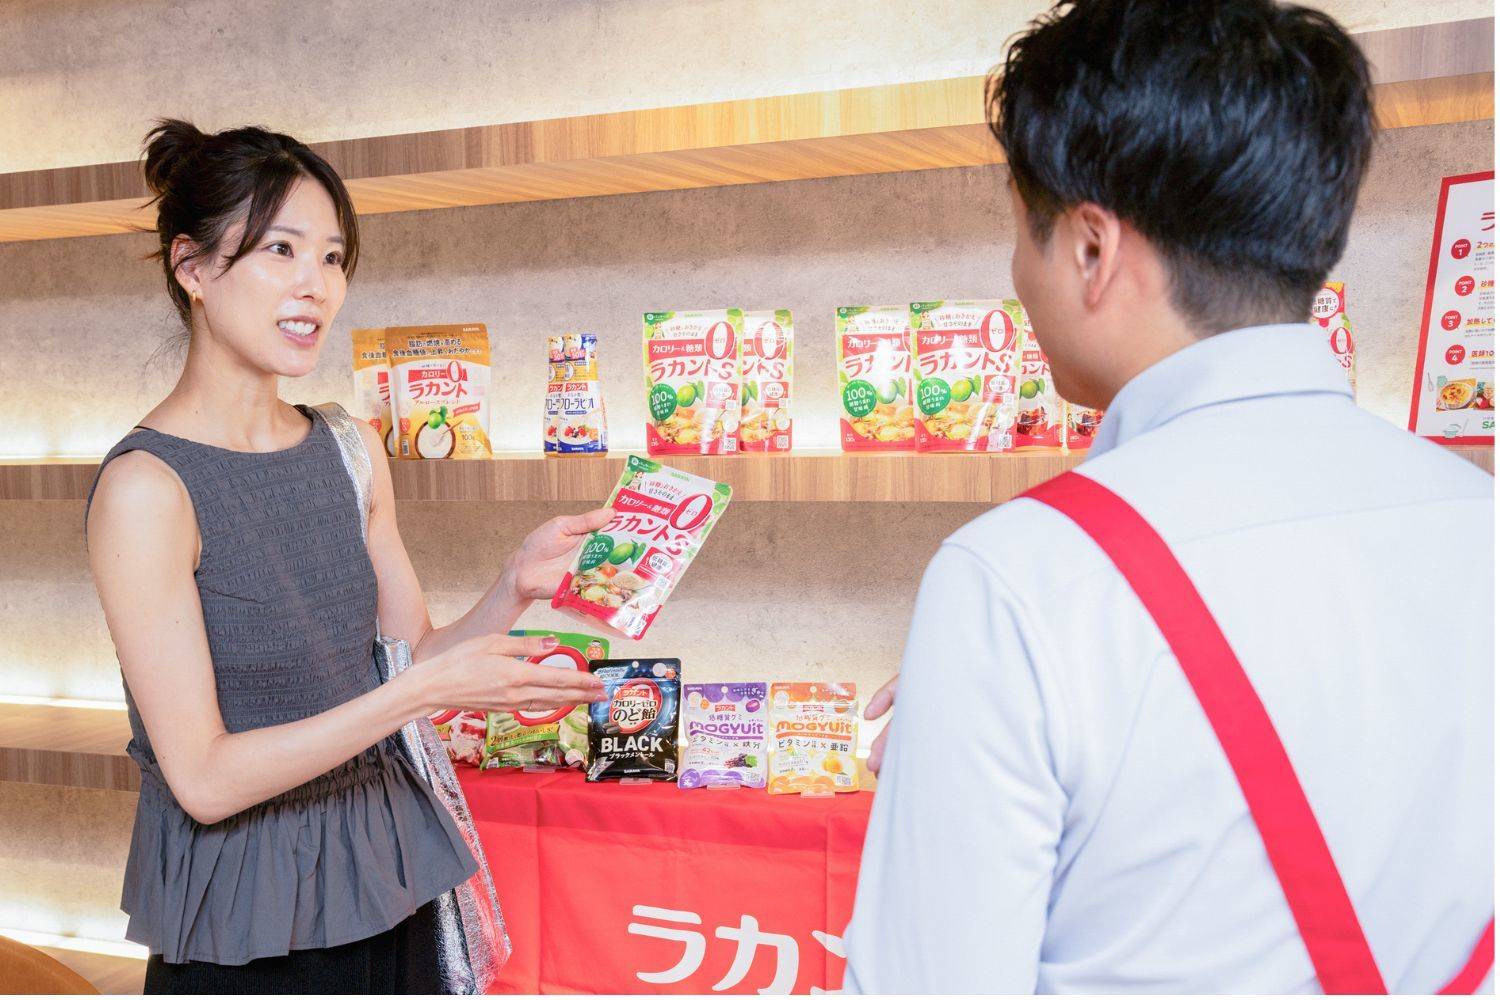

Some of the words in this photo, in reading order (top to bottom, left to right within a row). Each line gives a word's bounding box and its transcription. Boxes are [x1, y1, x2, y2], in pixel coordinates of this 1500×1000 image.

[409, 382, 467, 399] ラカント
[920, 386, 948, 397] 100%
[613, 700, 657, 708] カロリーゼロ
[613, 708, 656, 721] のど飴
[601, 735, 663, 753] BLACK
